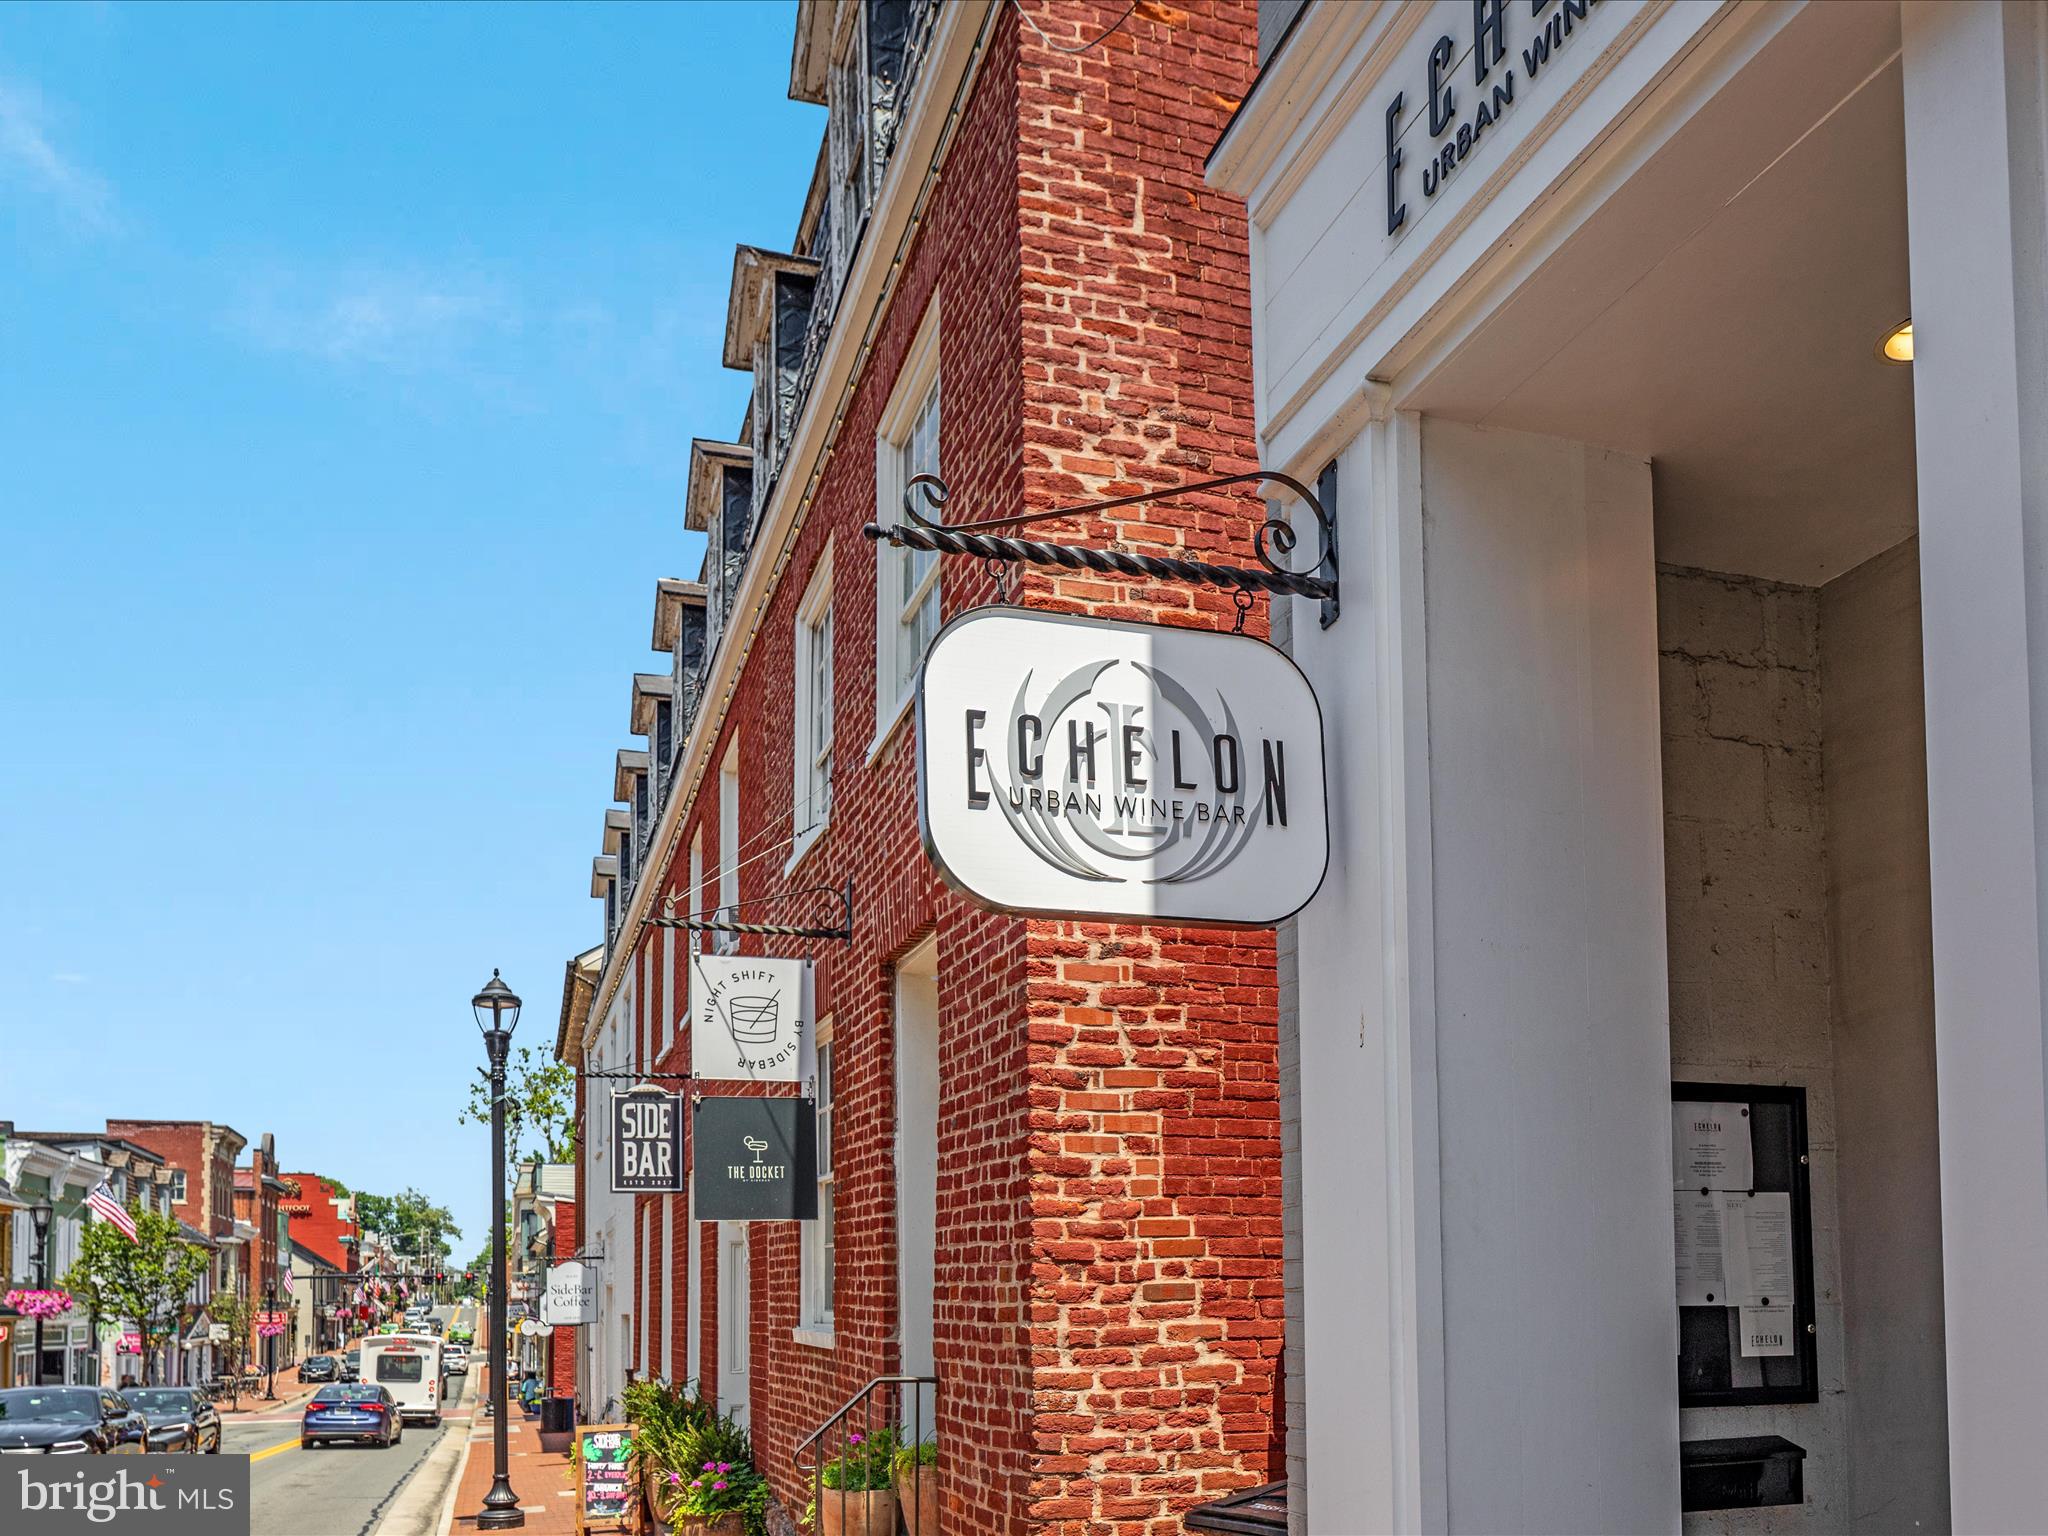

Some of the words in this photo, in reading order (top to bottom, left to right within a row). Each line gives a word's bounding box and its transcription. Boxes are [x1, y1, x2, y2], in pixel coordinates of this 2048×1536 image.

[1422, 70, 1514, 198] URBAN
[1522, 0, 1607, 78] WIN
[1386, 0, 1549, 236] ECH
[966, 709, 1288, 828] ECHELON
[1009, 785, 1102, 815] URBAN
[1113, 796, 1183, 821] WINE
[1198, 802, 1247, 825] BAR
[704, 981, 727, 1023] NIGHT
[731, 970, 775, 983] SHIFT
[794, 1020, 804, 1037] BY
[737, 1042, 797, 1070] SIDEBAR
[621, 1103, 672, 1139] SIDE
[622, 1141, 674, 1177] BAR
[728, 1166, 745, 1179] THE
[749, 1166, 785, 1179] DOCKET
[550, 1284, 593, 1295] SideBar
[553, 1296, 590, 1307] Coffee
[1751, 1335, 1783, 1347] ECHELON
